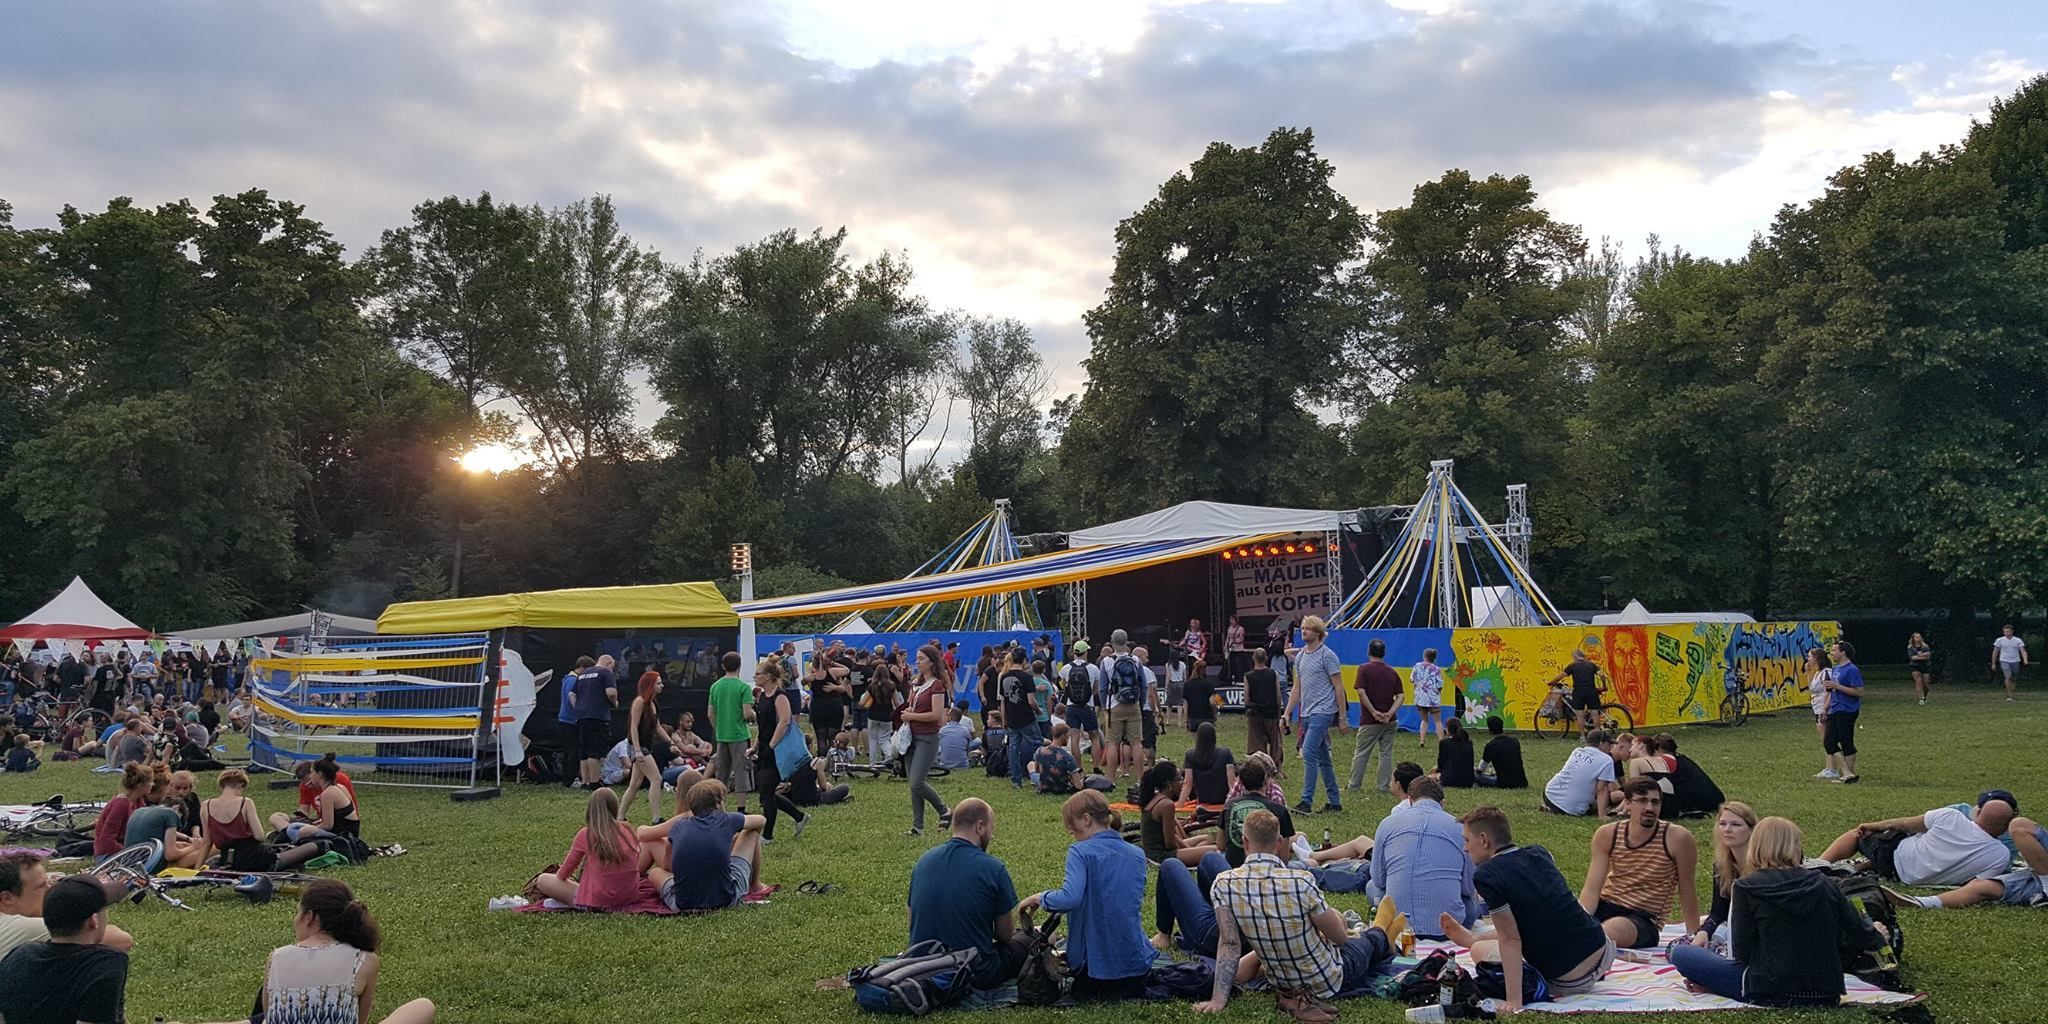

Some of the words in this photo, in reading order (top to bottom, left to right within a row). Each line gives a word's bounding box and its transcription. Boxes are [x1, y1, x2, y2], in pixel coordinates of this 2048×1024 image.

[1232, 559, 1265, 570] kickt
[1267, 556, 1287, 567] die
[1254, 562, 1327, 583] MAUER
[1237, 586, 1260, 598] aus
[1264, 582, 1292, 594] den
[1267, 592, 1331, 613] KÖPFE
